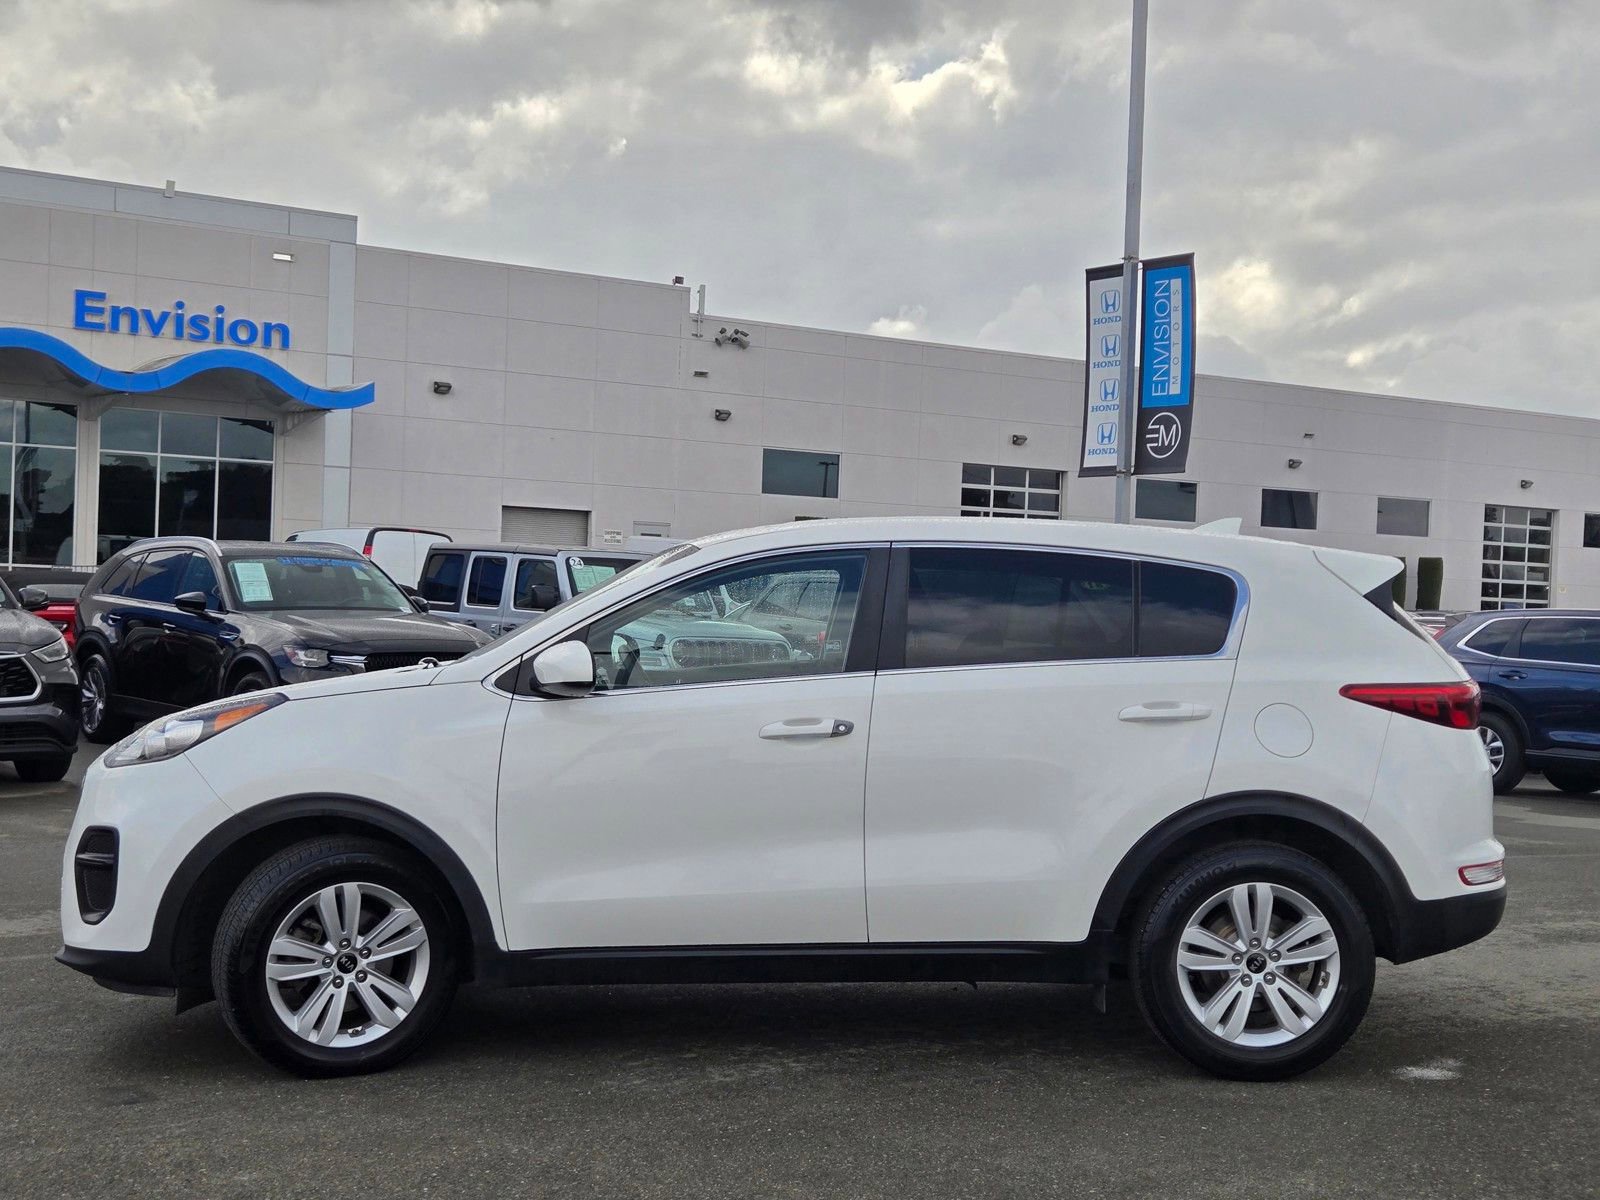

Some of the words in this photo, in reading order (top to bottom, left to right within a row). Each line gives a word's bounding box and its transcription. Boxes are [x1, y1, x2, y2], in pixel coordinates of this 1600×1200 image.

[73, 289, 291, 350] Envision
[1093, 316, 1121, 325] HOND
[1152, 279, 1170, 396] ENVISION
[1172, 289, 1180, 385] MOTORS
[1093, 360, 1120, 369] HOND
[1090, 404, 1119, 412] HOND
[340, 956, 355, 971] KIA
